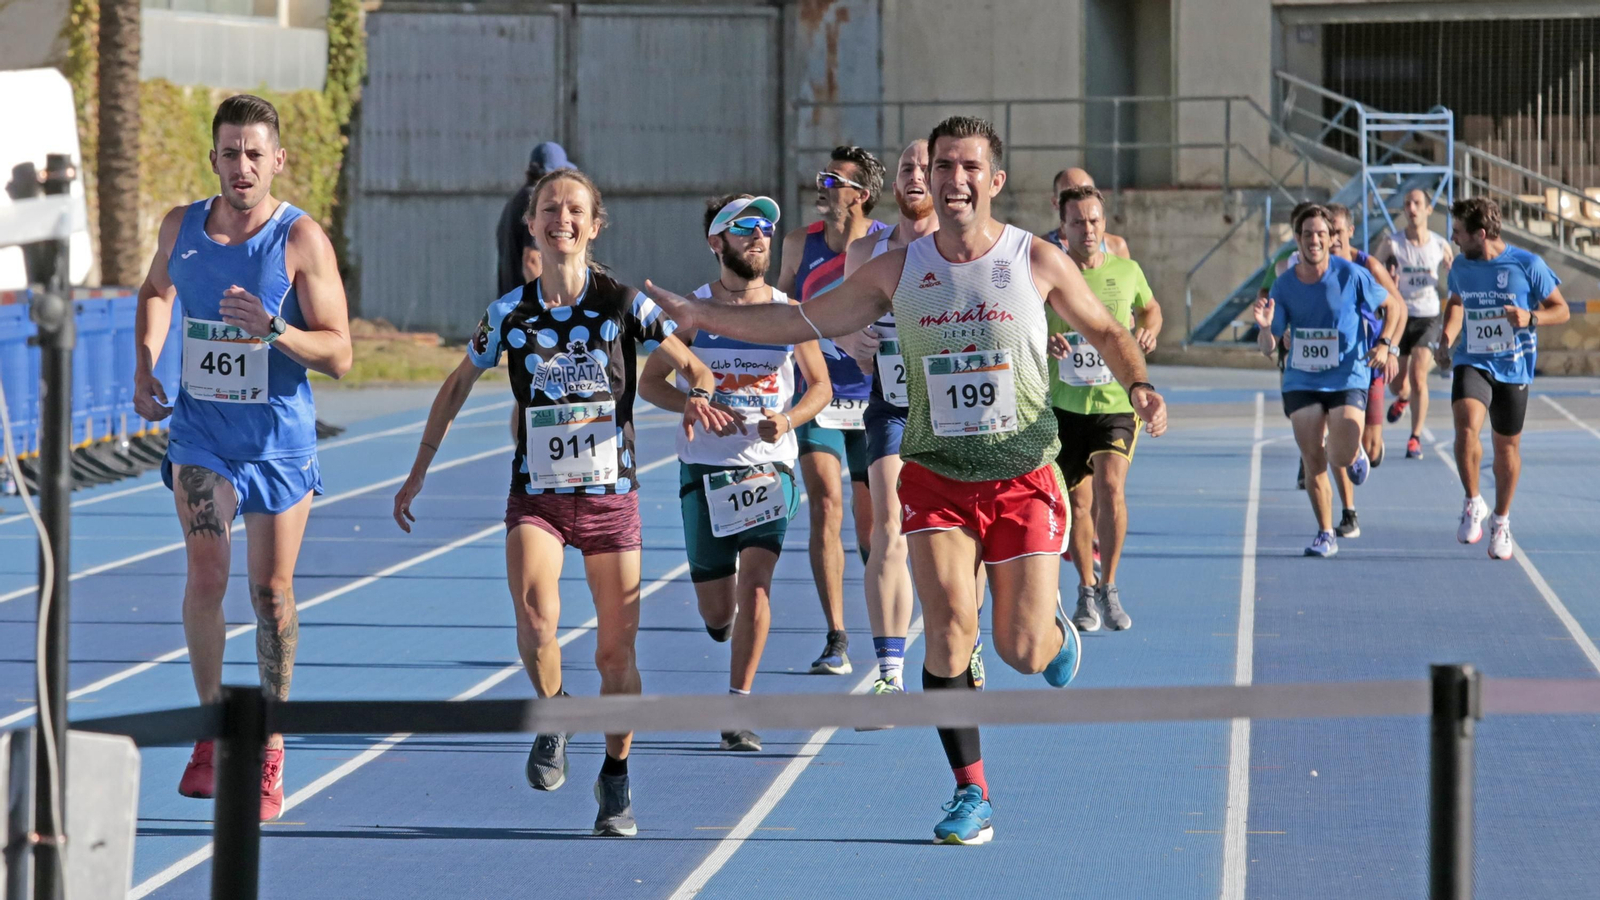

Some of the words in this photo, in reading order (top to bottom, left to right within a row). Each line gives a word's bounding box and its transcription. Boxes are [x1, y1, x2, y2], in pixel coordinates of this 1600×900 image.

[919, 301, 1014, 327] maratón
[943, 329, 986, 339] JEREZ
[1476, 325, 1502, 339] 204
[1302, 345, 1329, 358] 890
[200, 351, 245, 377] 461
[551, 364, 605, 383] PIRATA
[711, 360, 731, 370] Club
[533, 364, 548, 389] TRAIL
[564, 382, 594, 393] Jerez
[946, 383, 996, 409] 199
[549, 434, 596, 460] 911
[728, 486, 768, 511] 102
